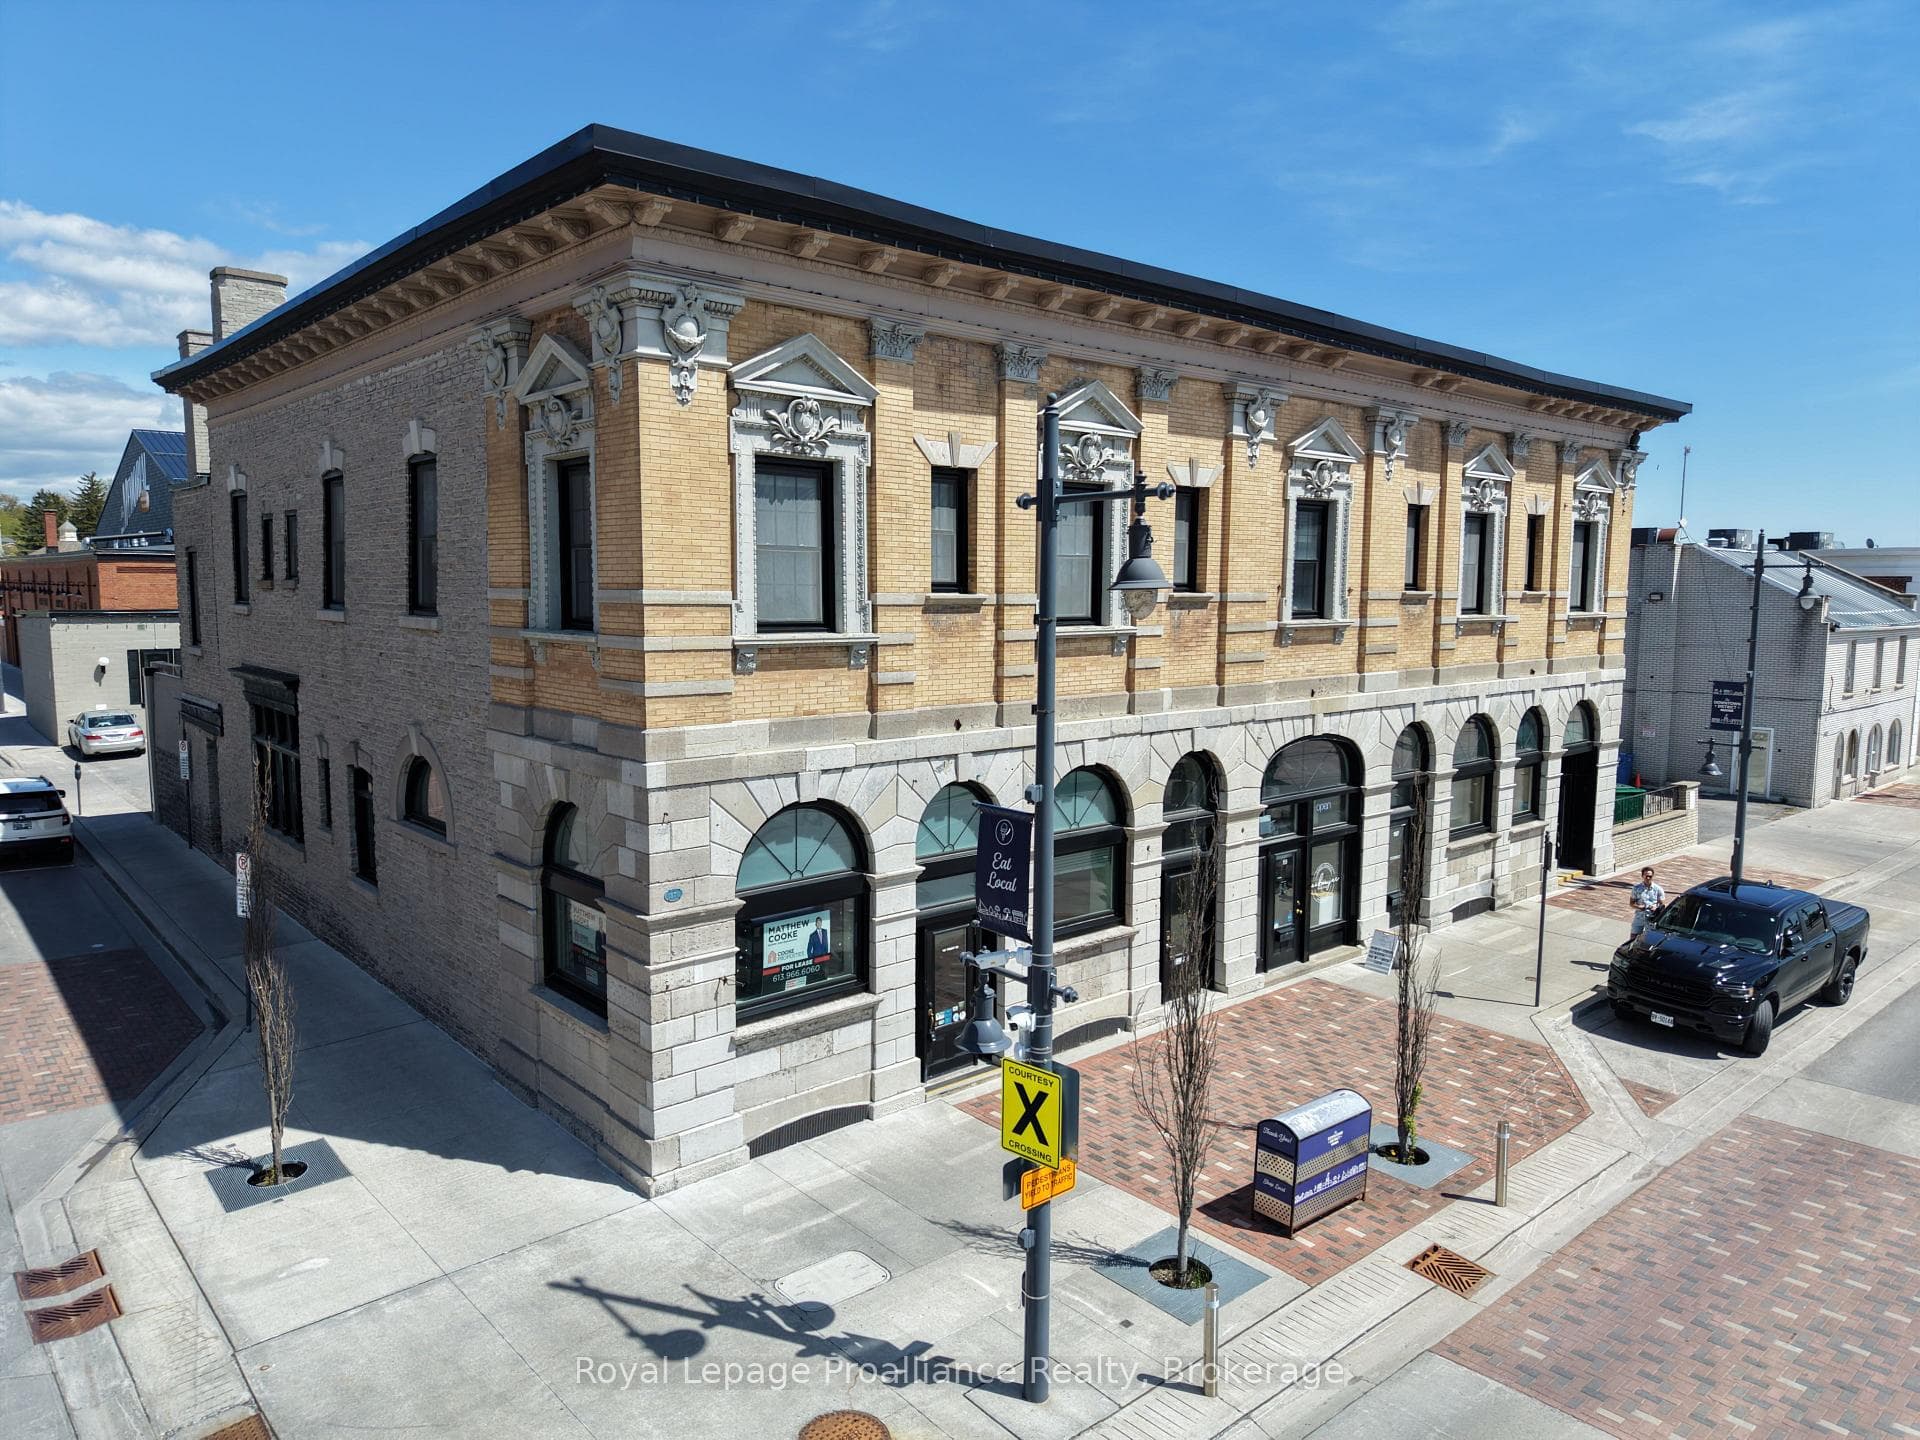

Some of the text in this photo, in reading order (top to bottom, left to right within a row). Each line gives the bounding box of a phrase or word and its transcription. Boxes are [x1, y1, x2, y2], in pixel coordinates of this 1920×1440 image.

[992, 851, 1012, 871] Eat
[986, 871, 1017, 892] Local
[768, 919, 810, 935] MATTHEW
[768, 930, 798, 943] COOKE
[781, 959, 814, 972] FOR LEASE
[1008, 1066, 1054, 1088] COURTESY
[1008, 1139, 1052, 1163] CROSSING
[1025, 1187, 1041, 1199] YIELD
[1042, 1182, 1050, 1192] TO
